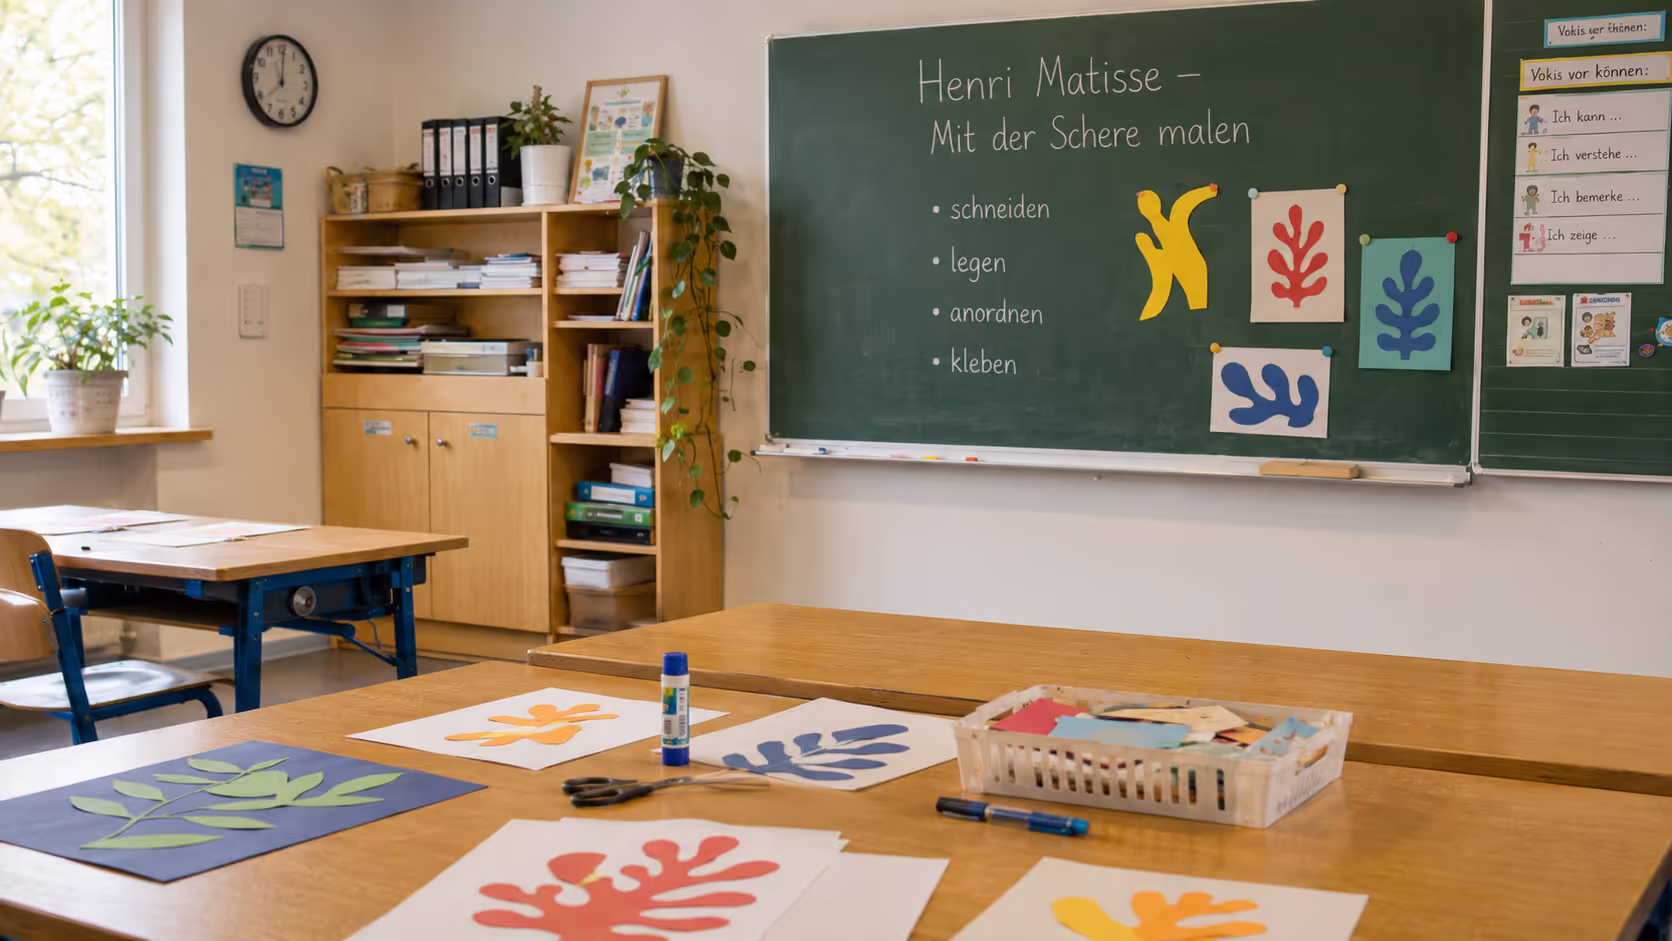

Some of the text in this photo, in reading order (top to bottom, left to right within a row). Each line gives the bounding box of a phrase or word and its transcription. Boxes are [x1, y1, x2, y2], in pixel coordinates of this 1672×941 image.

[919, 58, 1012, 103] Henri
[1036, 54, 1162, 97] Matisse
[1531, 64, 1649, 82] Vokis vor können:
[1552, 110, 1571, 124] Ich
[1577, 110, 1606, 122] kann
[930, 108, 1250, 154] Mit der Schere malen
[1550, 148, 1569, 162] Ich
[1575, 147, 1621, 160] verstehe
[951, 193, 1050, 219] schneiden
[1550, 189, 1570, 204] Ich
[1576, 189, 1623, 203] bemerke
[1547, 229, 1565, 241] Ich
[1570, 230, 1598, 244] zeige
[951, 246, 1006, 283] legen
[950, 298, 1043, 324] anordnen
[951, 347, 1017, 375] kleben
